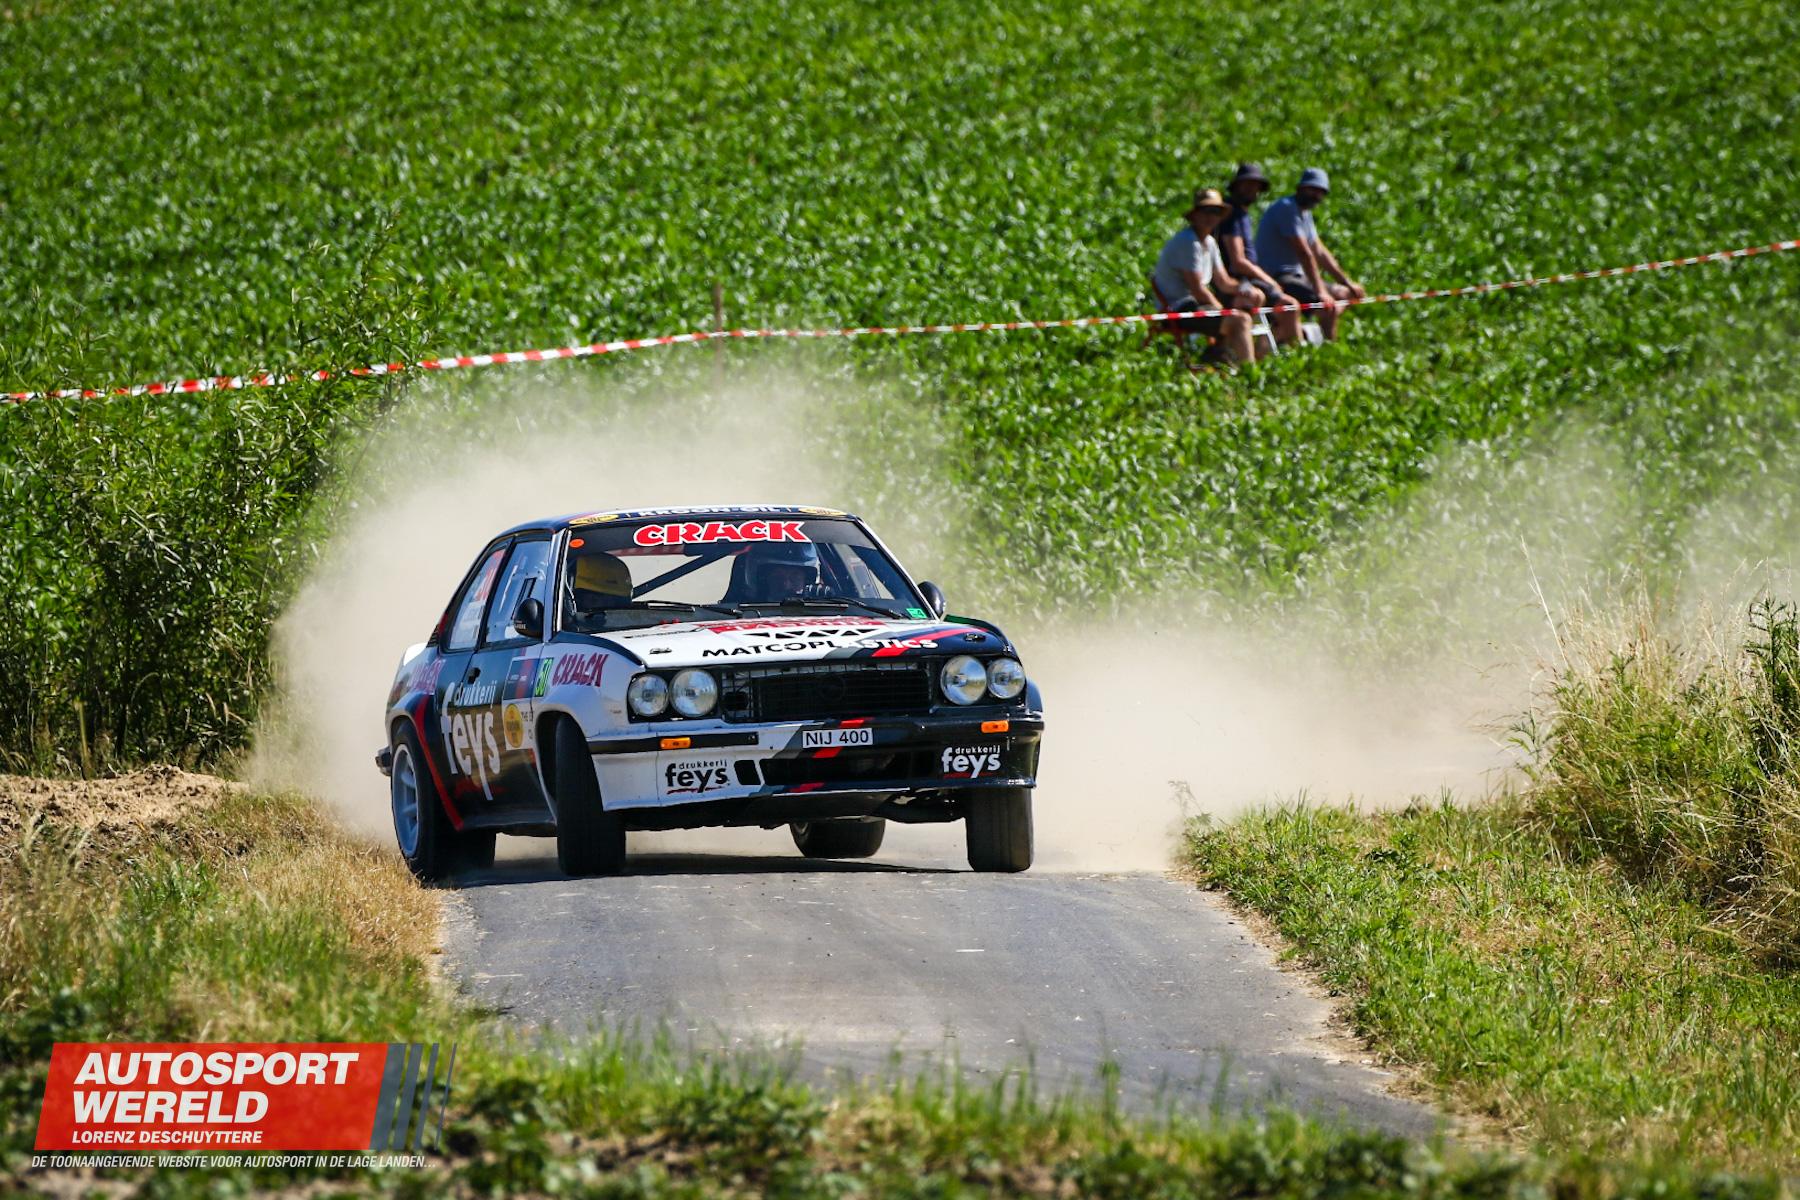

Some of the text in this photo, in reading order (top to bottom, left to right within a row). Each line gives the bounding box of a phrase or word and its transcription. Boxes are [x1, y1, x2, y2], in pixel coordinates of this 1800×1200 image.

[633, 519, 812, 546] CRACK
[702, 638, 939, 658] MATCOPLASTICS
[552, 652, 610, 688] CRACK
[454, 680, 497, 709] drukkerij
[440, 682, 500, 800] feys
[805, 730, 869, 745] NIJ 400
[954, 745, 1000, 754] drukkerij
[678, 759, 728, 769] drukkerij
[941, 746, 1002, 778] feys
[665, 763, 728, 793] feys
